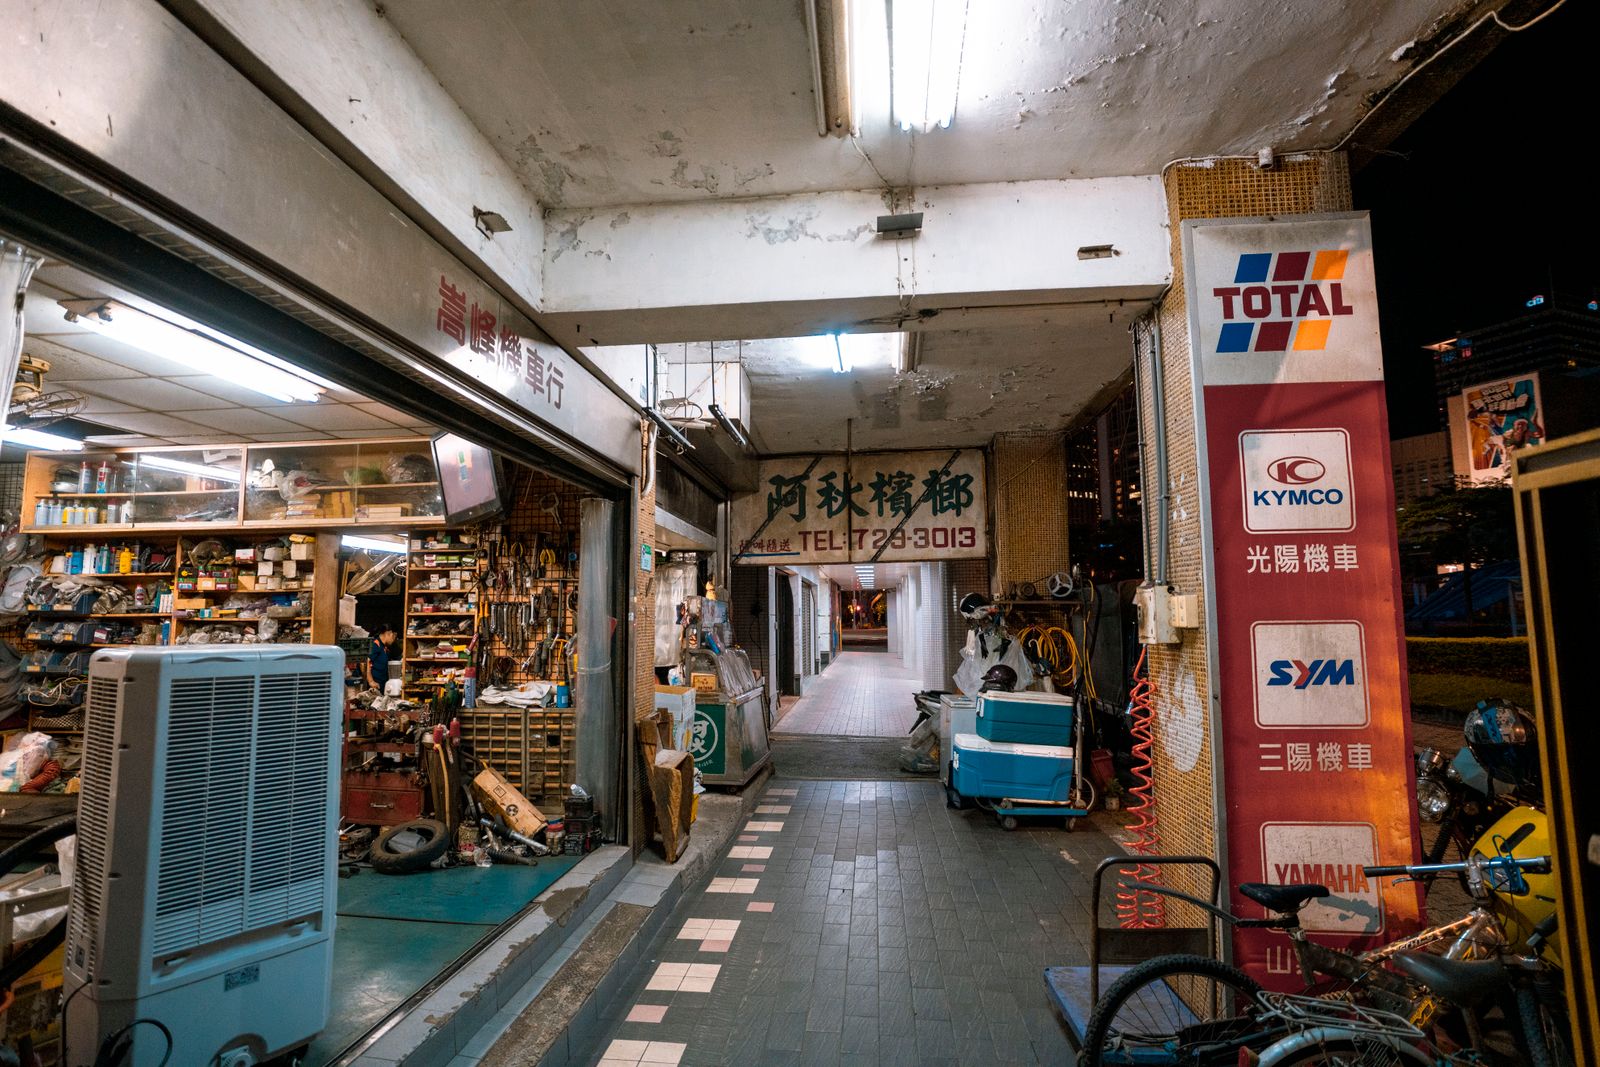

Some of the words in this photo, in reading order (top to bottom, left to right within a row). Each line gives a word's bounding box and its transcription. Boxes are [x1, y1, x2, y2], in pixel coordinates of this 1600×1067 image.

[1213, 282, 1354, 319] TOTAL
[767, 469, 975, 523] 阿秋檳榔
[1253, 488, 1343, 506] KYMCO
[1246, 543, 1360, 574] 光陽機車
[1266, 659, 1355, 690] SYM
[1259, 742, 1373, 774] 三陽機車
[1274, 863, 1370, 893] YAMAHA
